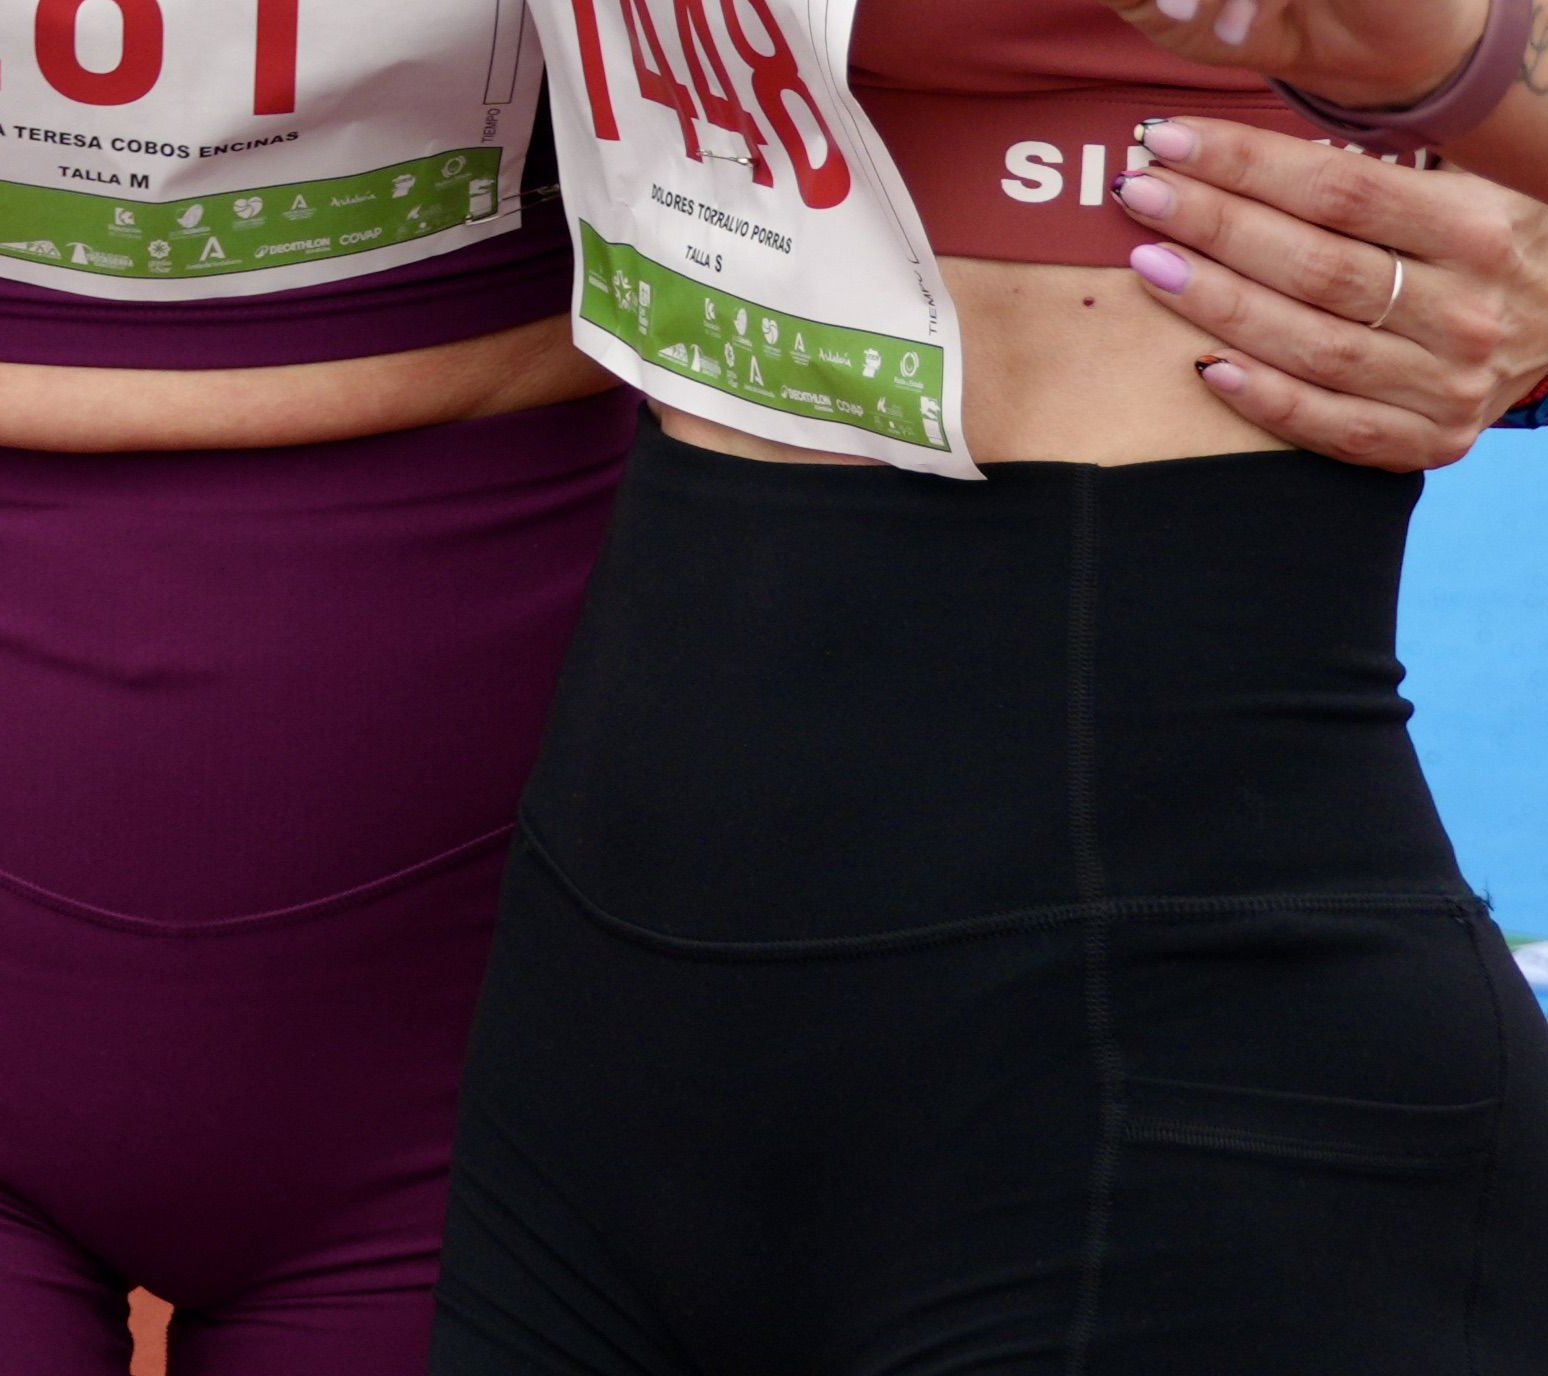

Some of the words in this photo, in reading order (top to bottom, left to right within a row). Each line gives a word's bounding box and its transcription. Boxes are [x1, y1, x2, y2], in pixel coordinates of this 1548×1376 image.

[480, 108, 502, 143] TIEMPO
[14, 125, 102, 150] TERESA
[111, 137, 190, 159] COBOS
[199, 131, 300, 158] ENCINAS
[59, 166, 121, 185] TALLA
[130, 173, 149, 189] M
[651, 182, 695, 217] DOLORES
[697, 202, 750, 238] TORRALVO
[752, 224, 793, 254] PORRAS
[269, 238, 331, 255] DECATHLON
[339, 227, 383, 245] COVAP
[684, 245, 711, 269] TALLA
[714, 253, 723, 273] S
